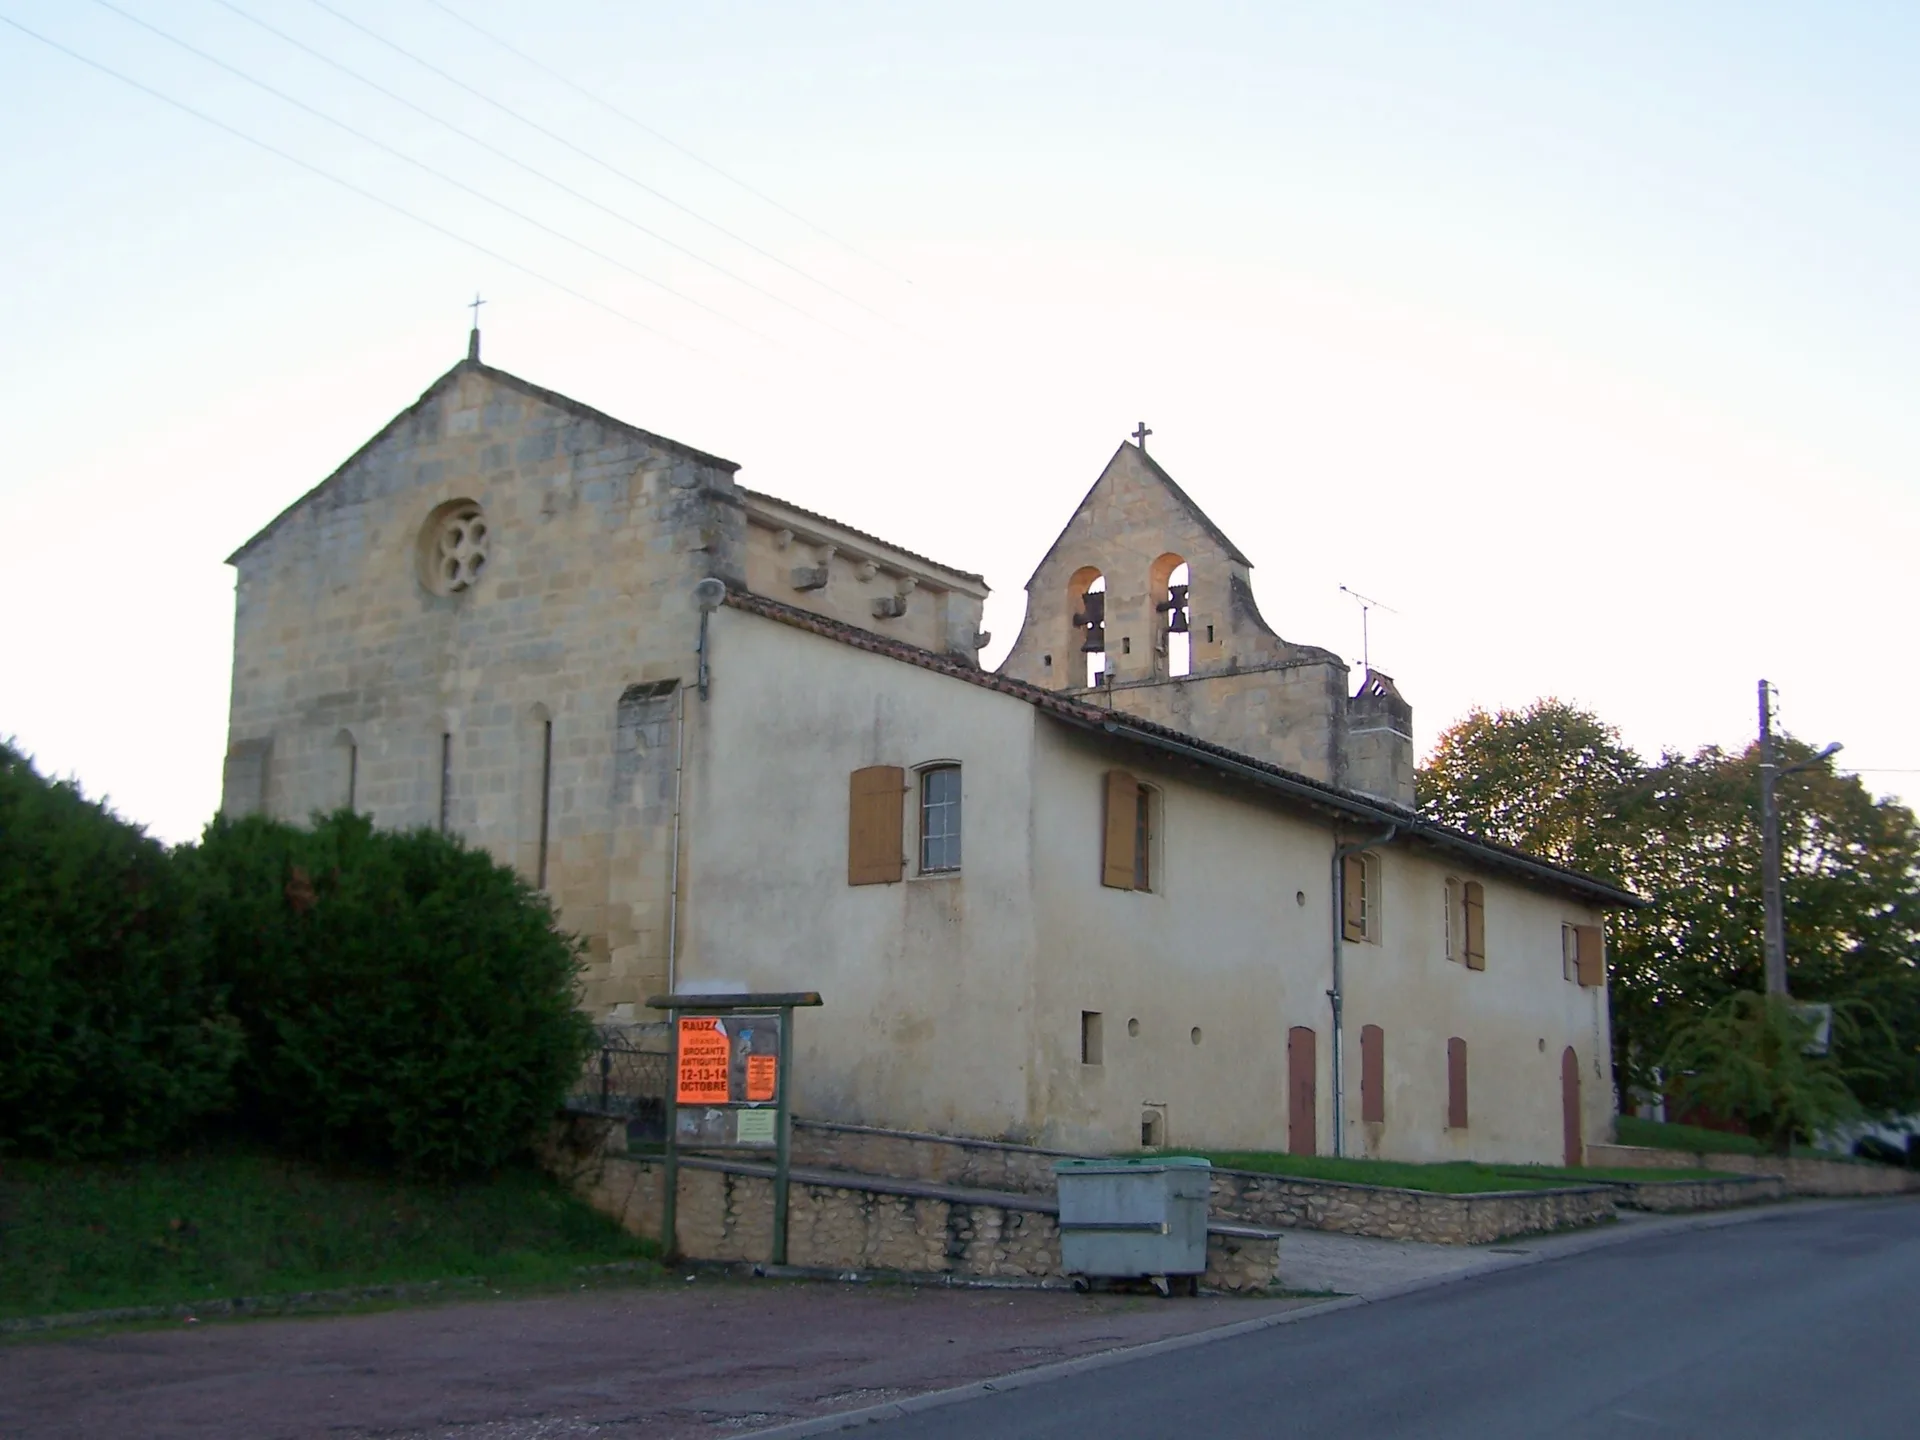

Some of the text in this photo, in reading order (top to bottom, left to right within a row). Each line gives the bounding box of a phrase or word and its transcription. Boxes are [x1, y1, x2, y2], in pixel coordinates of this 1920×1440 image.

[683, 1046, 726, 1056] BROCANTE
[681, 1068, 727, 1080] 12-13-14
[680, 1081, 726, 1092] OCTOBRE
